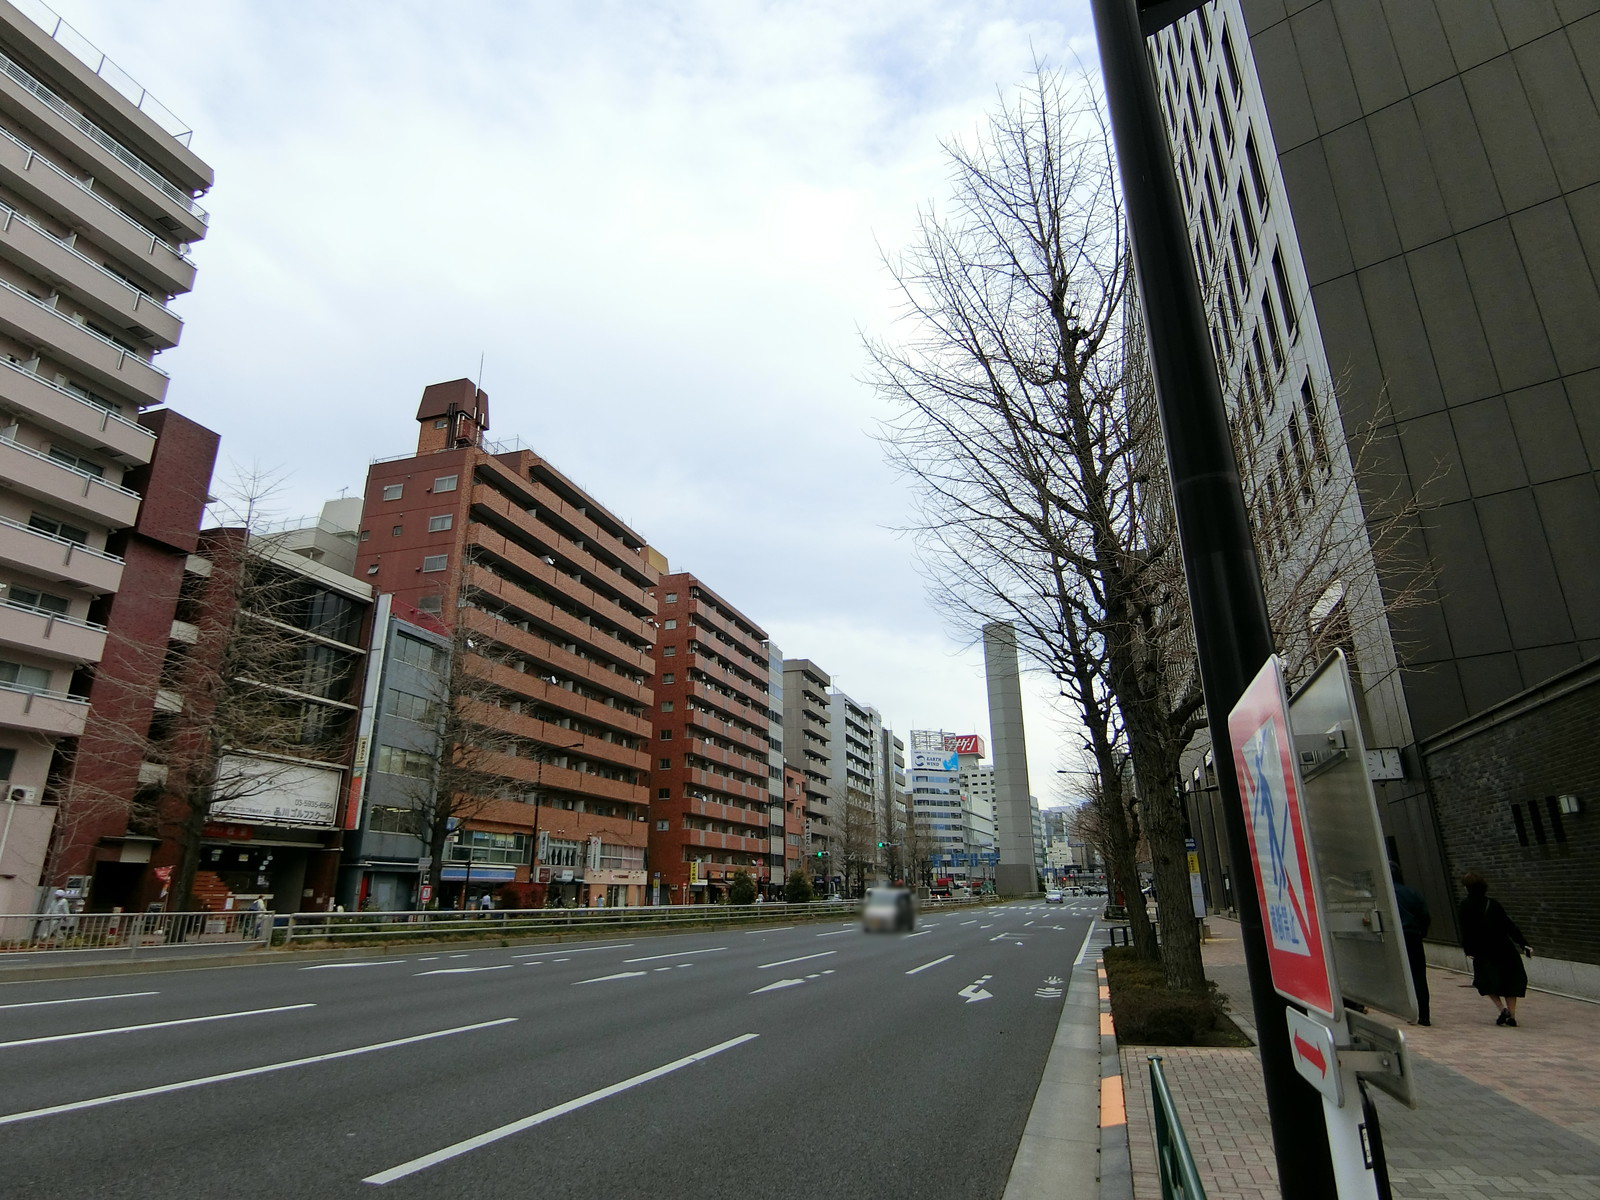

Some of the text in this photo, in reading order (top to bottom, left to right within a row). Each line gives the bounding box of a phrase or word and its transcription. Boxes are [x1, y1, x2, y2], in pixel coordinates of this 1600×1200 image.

[273, 806, 332, 821] 品川ゴルフスクール
[1270, 903, 1300, 945] 横断禁止
